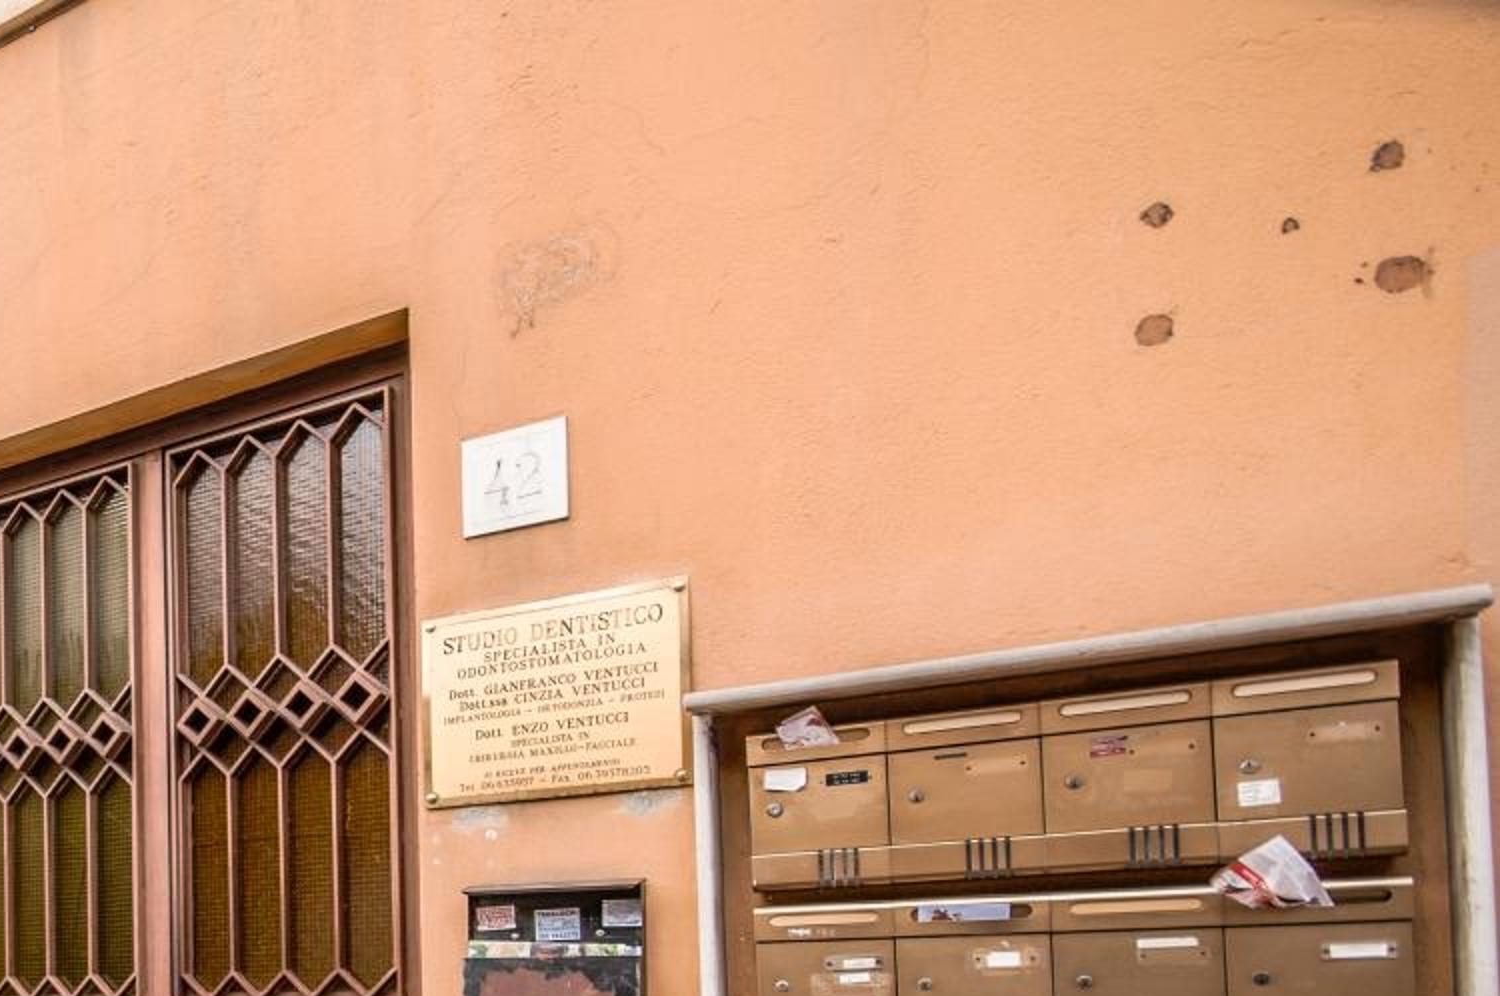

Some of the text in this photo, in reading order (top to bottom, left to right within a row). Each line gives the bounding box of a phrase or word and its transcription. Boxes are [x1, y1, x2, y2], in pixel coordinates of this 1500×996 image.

[483, 451, 542, 505] 42
[443, 603, 663, 655] STUDIO DENTISTICO
[457, 642, 647, 680] ODONTOSTOMATOLOGIA
[483, 633, 616, 662] SPECIALISTA IN
[483, 673, 577, 695] GIANFRANCO
[583, 661, 659, 681] VENTUCCI
[514, 688, 564, 704] CINZIA
[572, 677, 645, 696] VENTUCCI
[512, 721, 549, 736] ENZO
[556, 711, 629, 729] VENTUCCI
